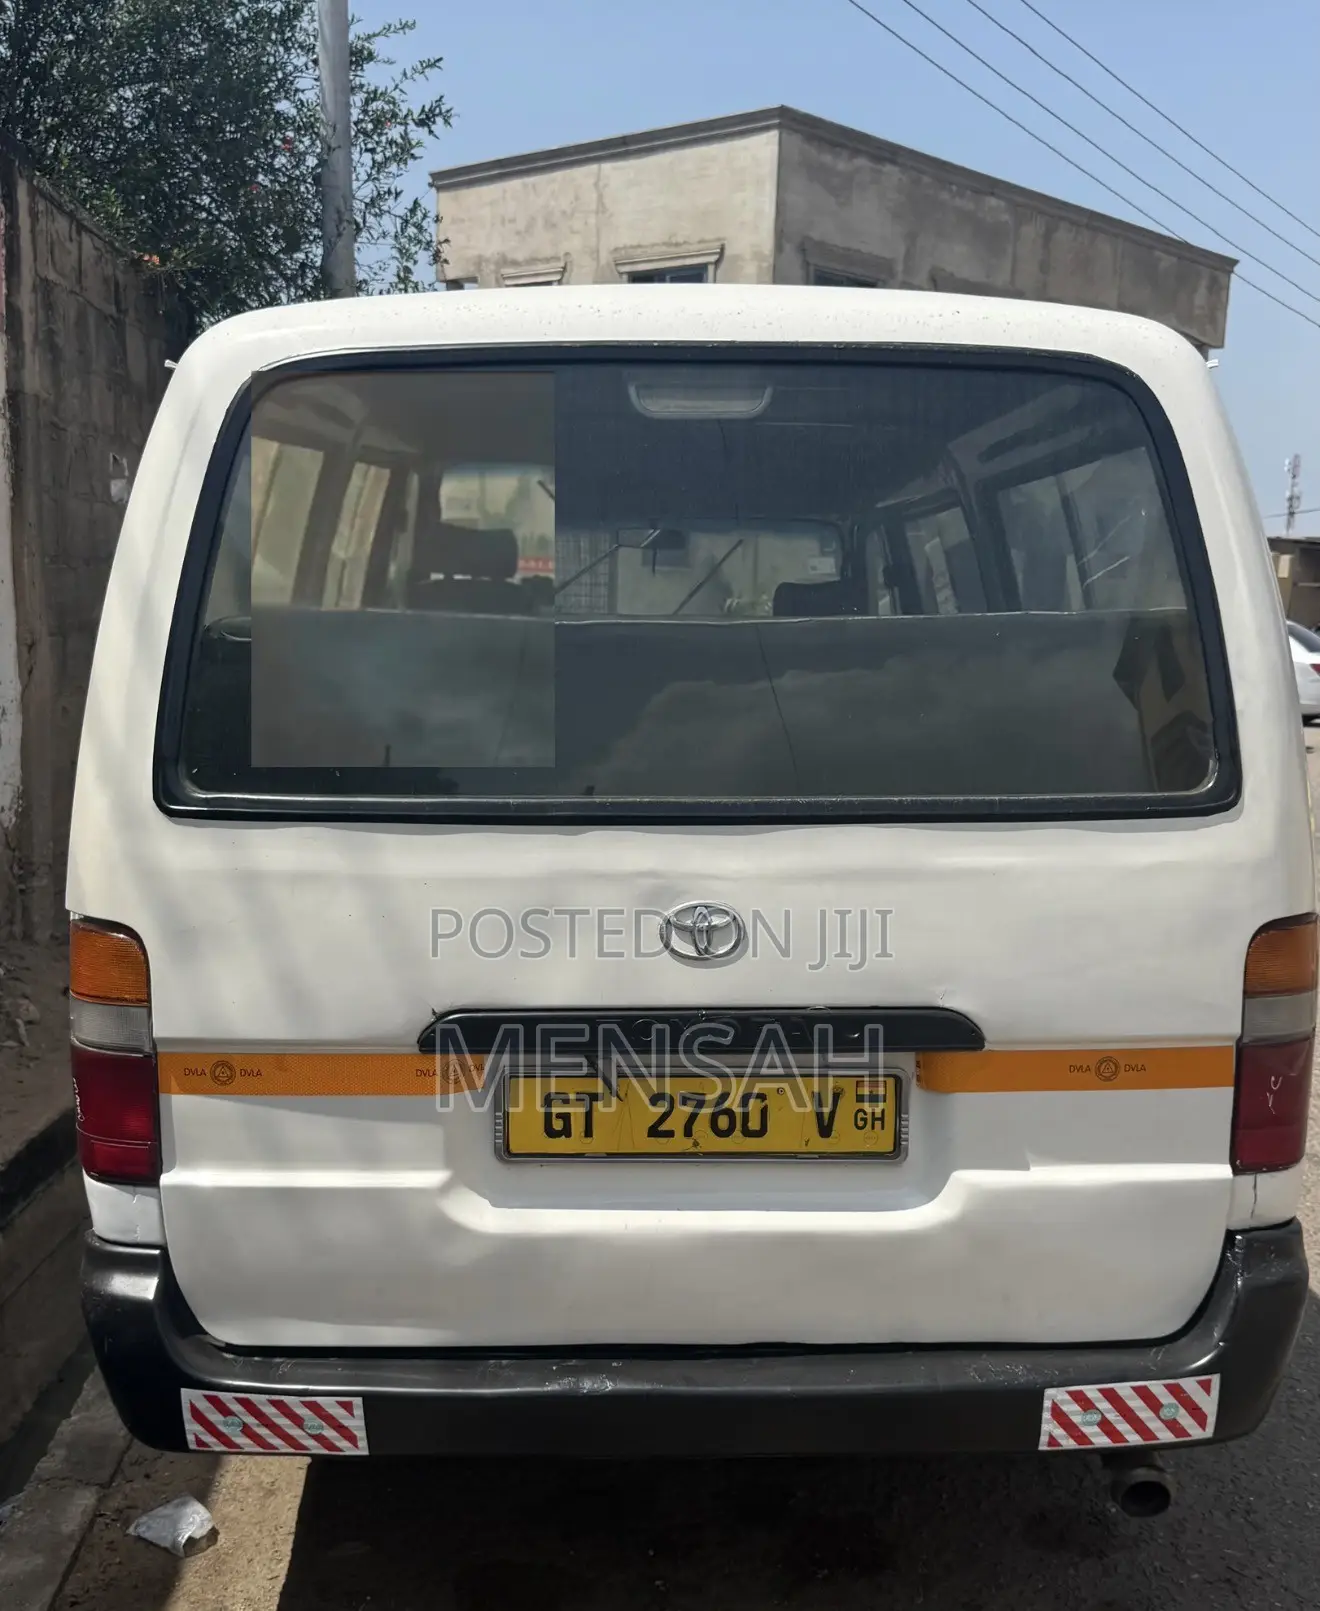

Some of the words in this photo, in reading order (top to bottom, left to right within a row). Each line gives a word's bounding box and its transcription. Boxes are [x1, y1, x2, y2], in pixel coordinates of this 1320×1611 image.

[183, 1067, 207, 1077] DVLA
[239, 1068, 263, 1077] DVLA
[1068, 1064, 1092, 1074] DVLA
[1123, 1064, 1147, 1073] DVLA
[543, 1091, 604, 1139] GT
[647, 1091, 768, 1139] 2760
[811, 1090, 843, 1139] V
[853, 1108, 886, 1131] GH
